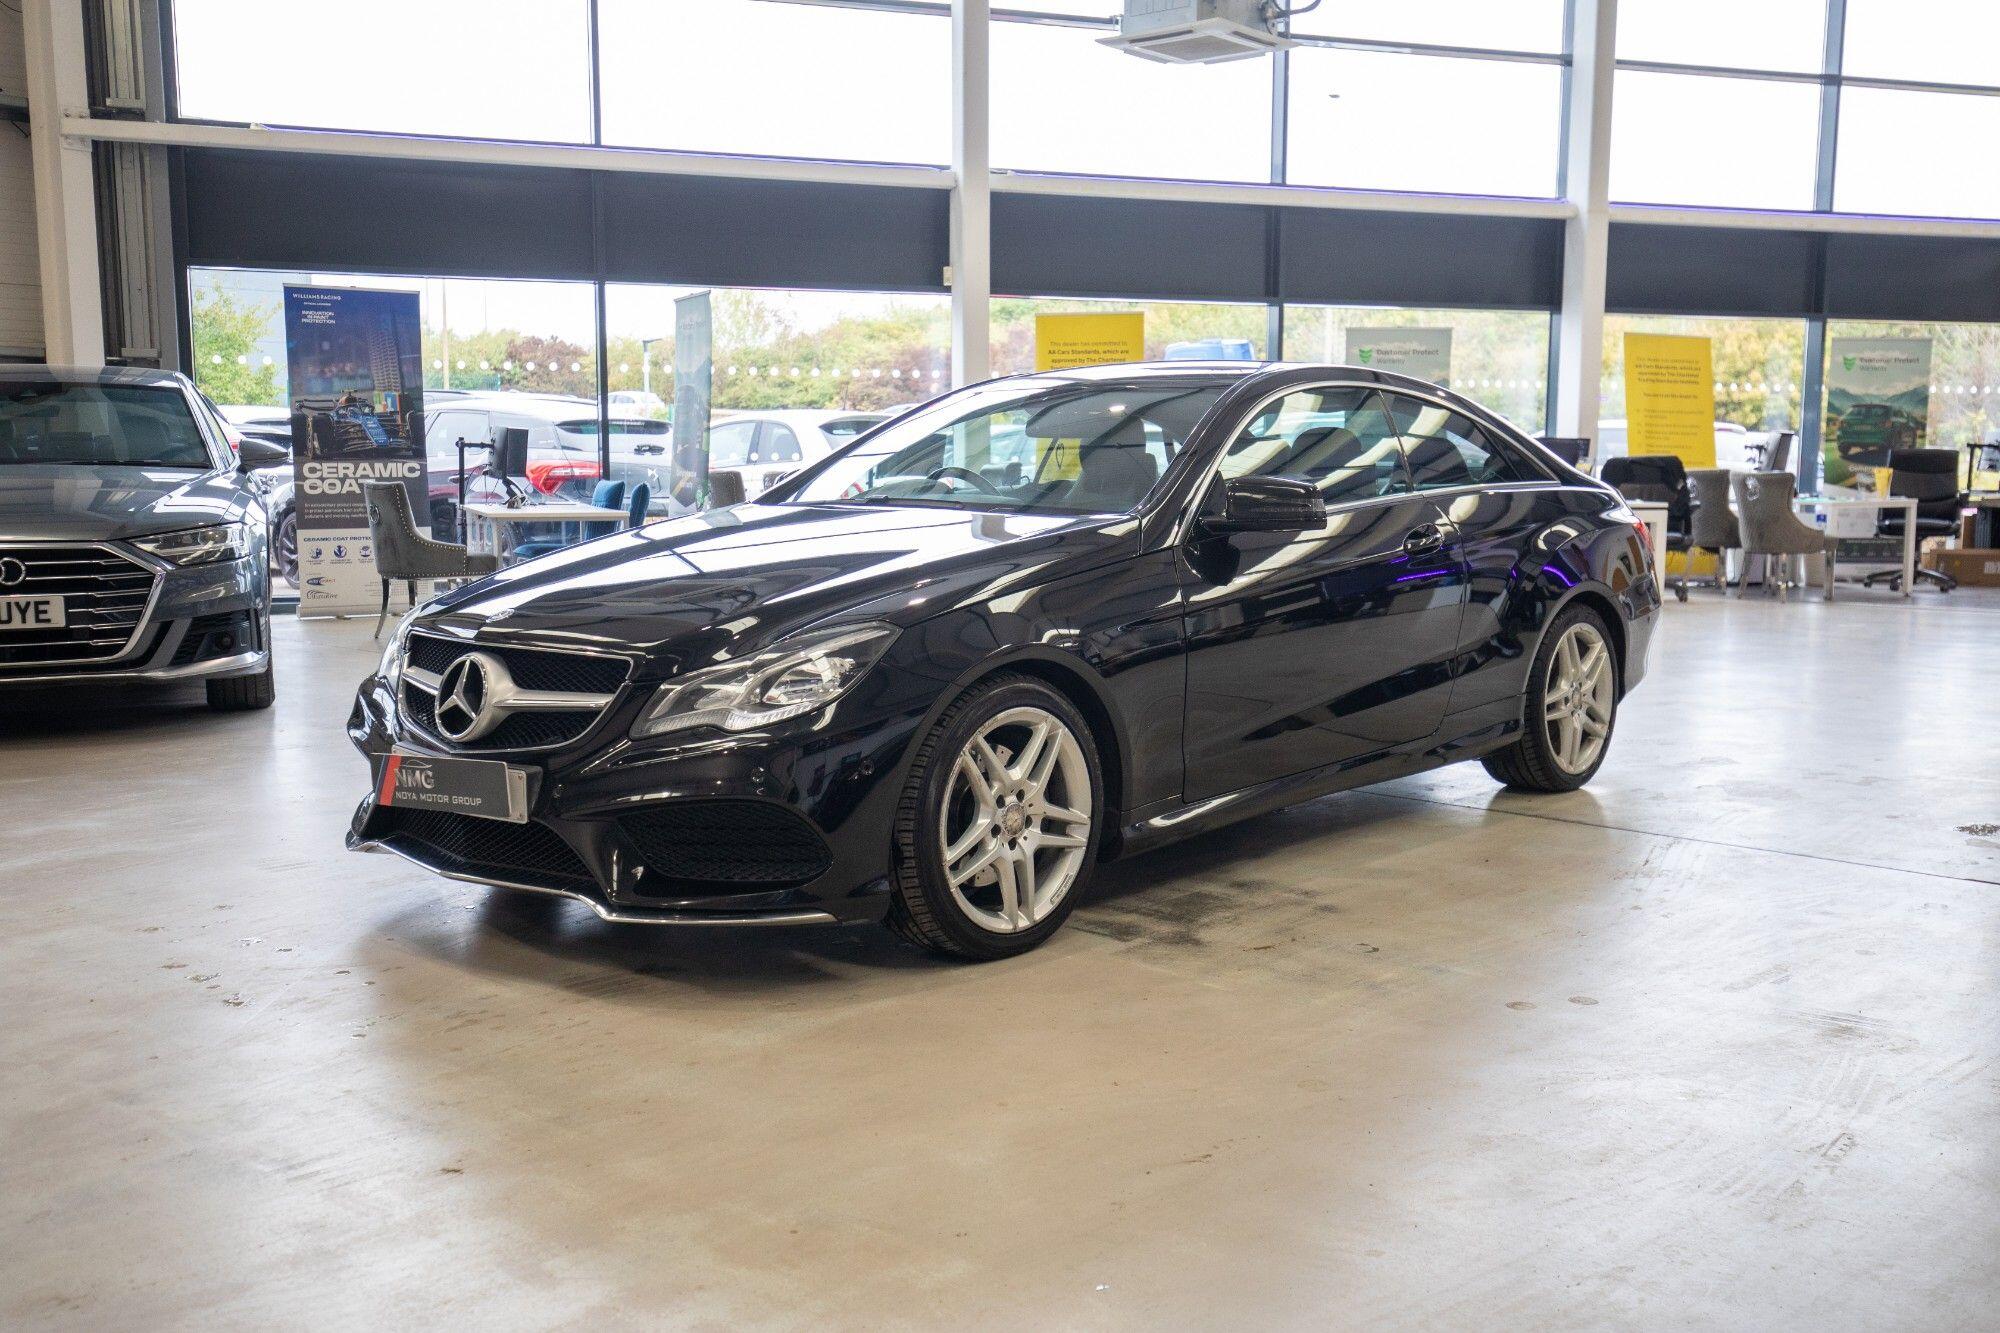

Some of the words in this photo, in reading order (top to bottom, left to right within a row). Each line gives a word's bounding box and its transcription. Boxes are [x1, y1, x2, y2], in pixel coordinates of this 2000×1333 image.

[302, 461, 421, 479] CERAMIC
[393, 767, 435, 789] NMG
[395, 791, 417, 801] NOYA
[419, 792, 450, 804] MOTOR
[452, 795, 482, 806] GROUP
